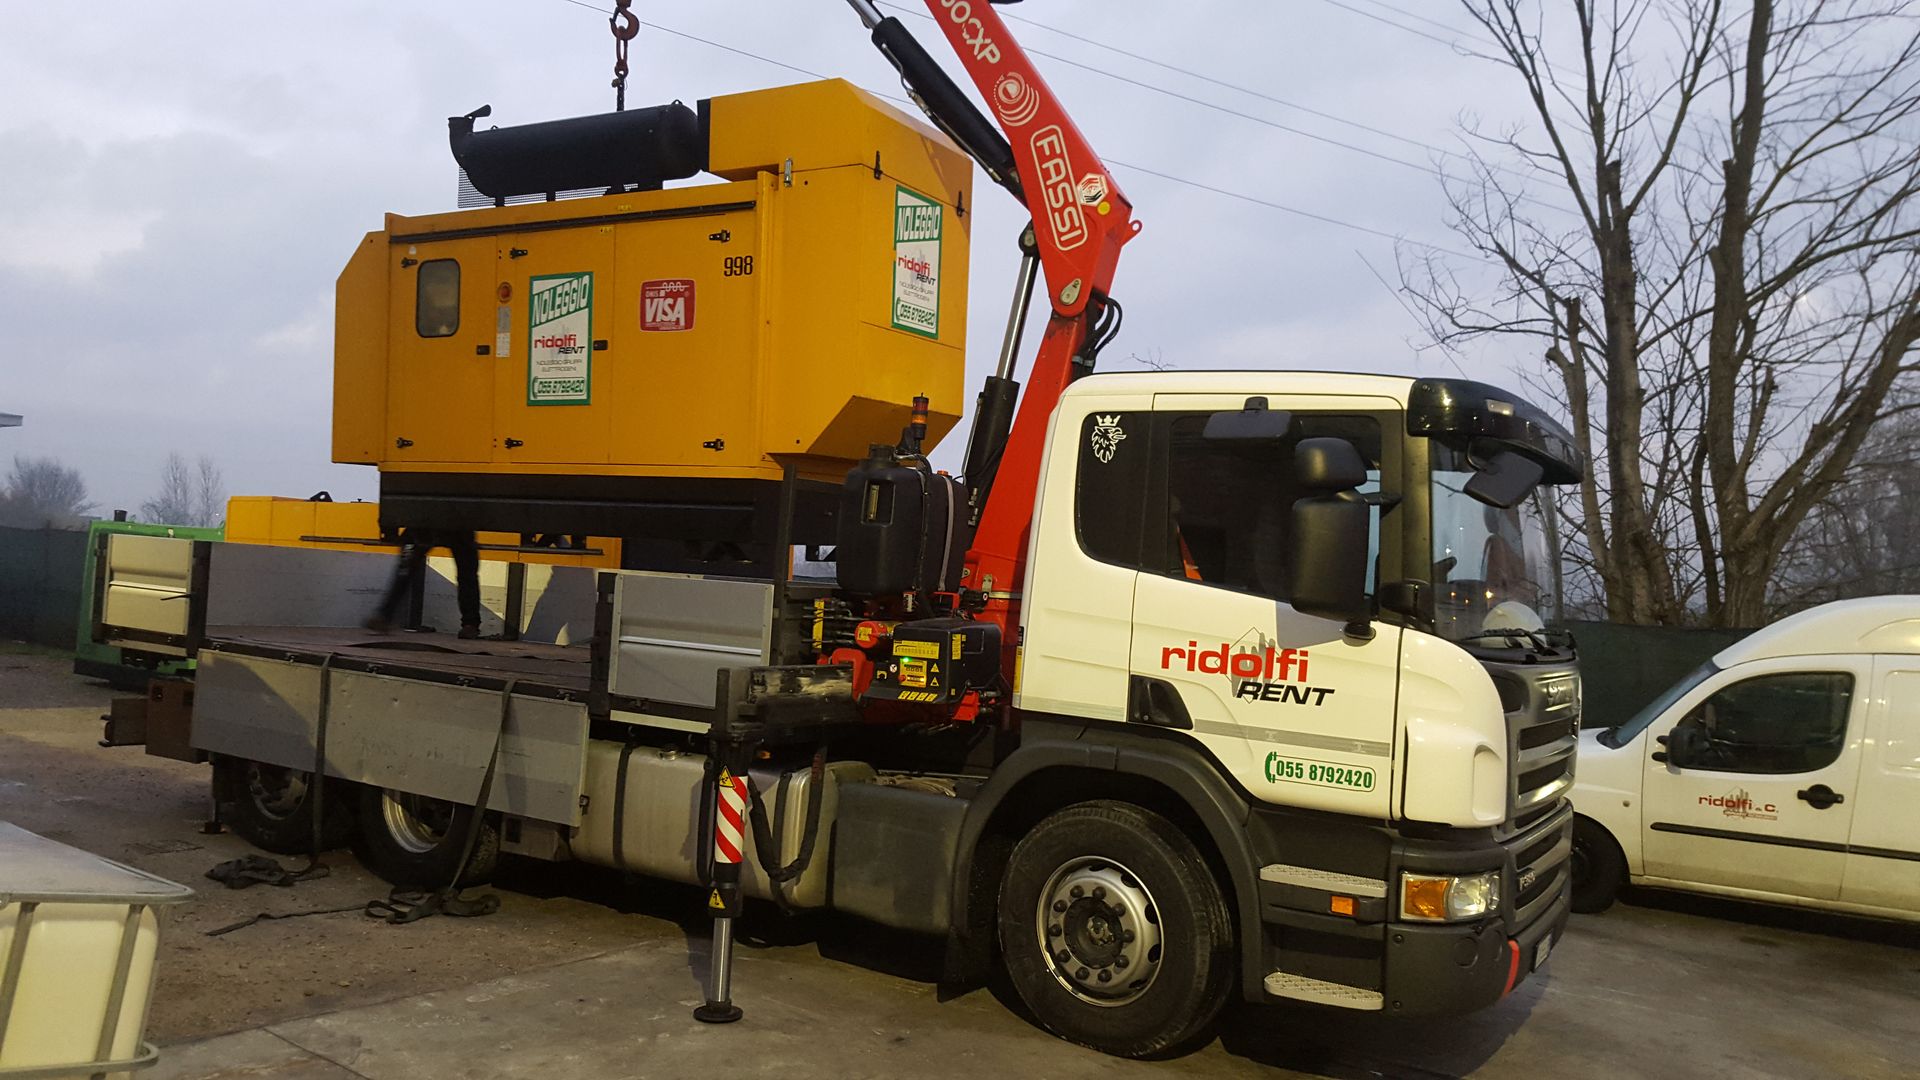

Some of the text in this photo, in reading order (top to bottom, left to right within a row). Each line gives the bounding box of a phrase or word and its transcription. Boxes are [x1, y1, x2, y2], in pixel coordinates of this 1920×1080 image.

[1036, 134, 1082, 244] FASSI
[896, 206, 940, 241] NOLEGGIO
[724, 255, 753, 277] 998
[898, 255, 930, 277] ridolfi
[916, 274, 936, 286] RENT
[532, 275, 590, 325] NOLEGGIO
[645, 297, 685, 326] VISA
[900, 303, 936, 327] 055 8792420
[534, 334, 577, 349] ridolfi
[557, 346, 586, 355] RENT
[538, 379, 585, 394] 055 8792420
[1161, 640, 1309, 683] ridolfi
[1236, 681, 1336, 707] RENT
[1275, 759, 1373, 789] 055 8792420
[1698, 795, 1752, 810] ridolfi
